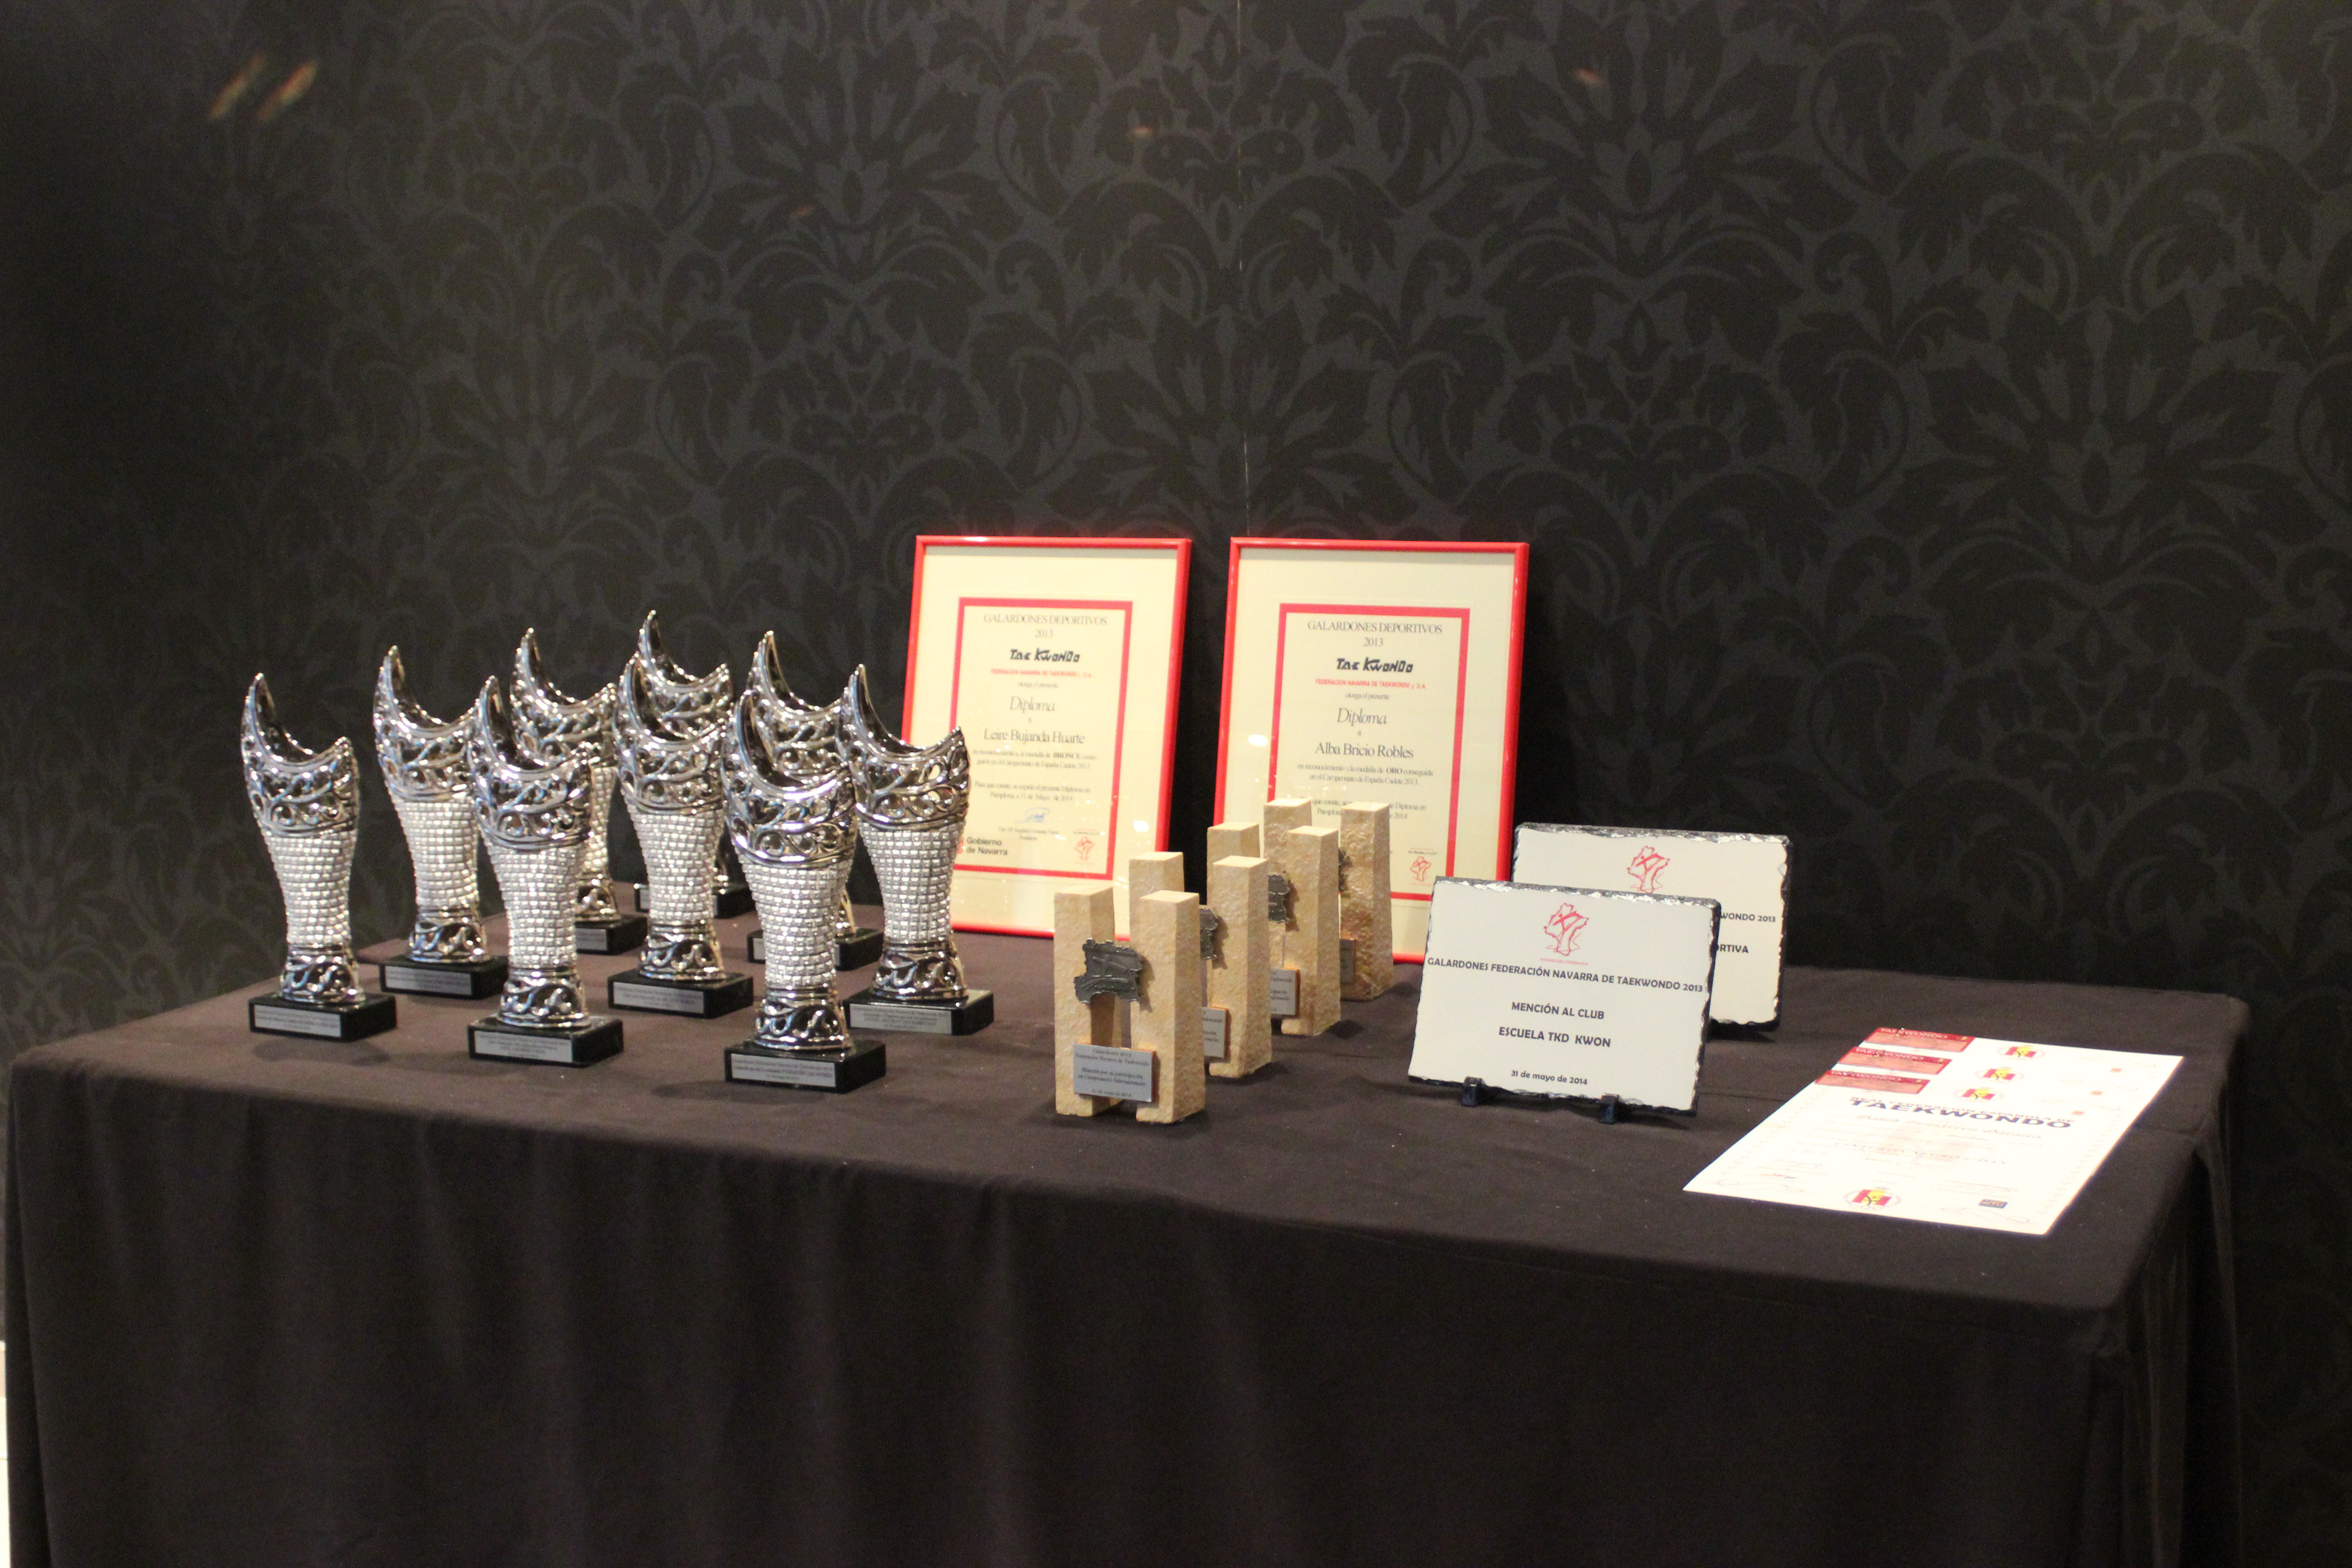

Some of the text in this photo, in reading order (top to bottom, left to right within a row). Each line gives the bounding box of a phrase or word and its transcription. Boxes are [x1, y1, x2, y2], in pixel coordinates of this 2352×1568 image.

[984, 613, 1107, 625] GALARDONES DEPORTIVOS
[1308, 620, 1442, 634] GALARDONES DEPORTIVOS
[1035, 629, 1053, 638] 2013
[1363, 637, 1383, 647] 2013
[1009, 696, 1055, 713] Diploma
[1337, 707, 1387, 726] Diploma
[984, 728, 1085, 744] Leire Bujanda Huarte
[1315, 741, 1414, 758] Alba Bricio Robles
[966, 837, 1002, 846] Gobierno
[978, 847, 1008, 856] Navarra
[1428, 957, 1703, 992] GALARDONES FEDERACIÓN NAVARRA DE TAEKWONDO 2013
[1511, 1001, 1604, 1019] MENCIÓN AL CLUB
[1499, 1026, 1611, 1048] ESCUELA TKD KWON
[1520, 1070, 1530, 1078] de
[1532, 1073, 1555, 1082] mayo
[1557, 1074, 1567, 1083] de
[1569, 1077, 1588, 1085] 2014
[1849, 1099, 2071, 1128] TAEKWONDO
